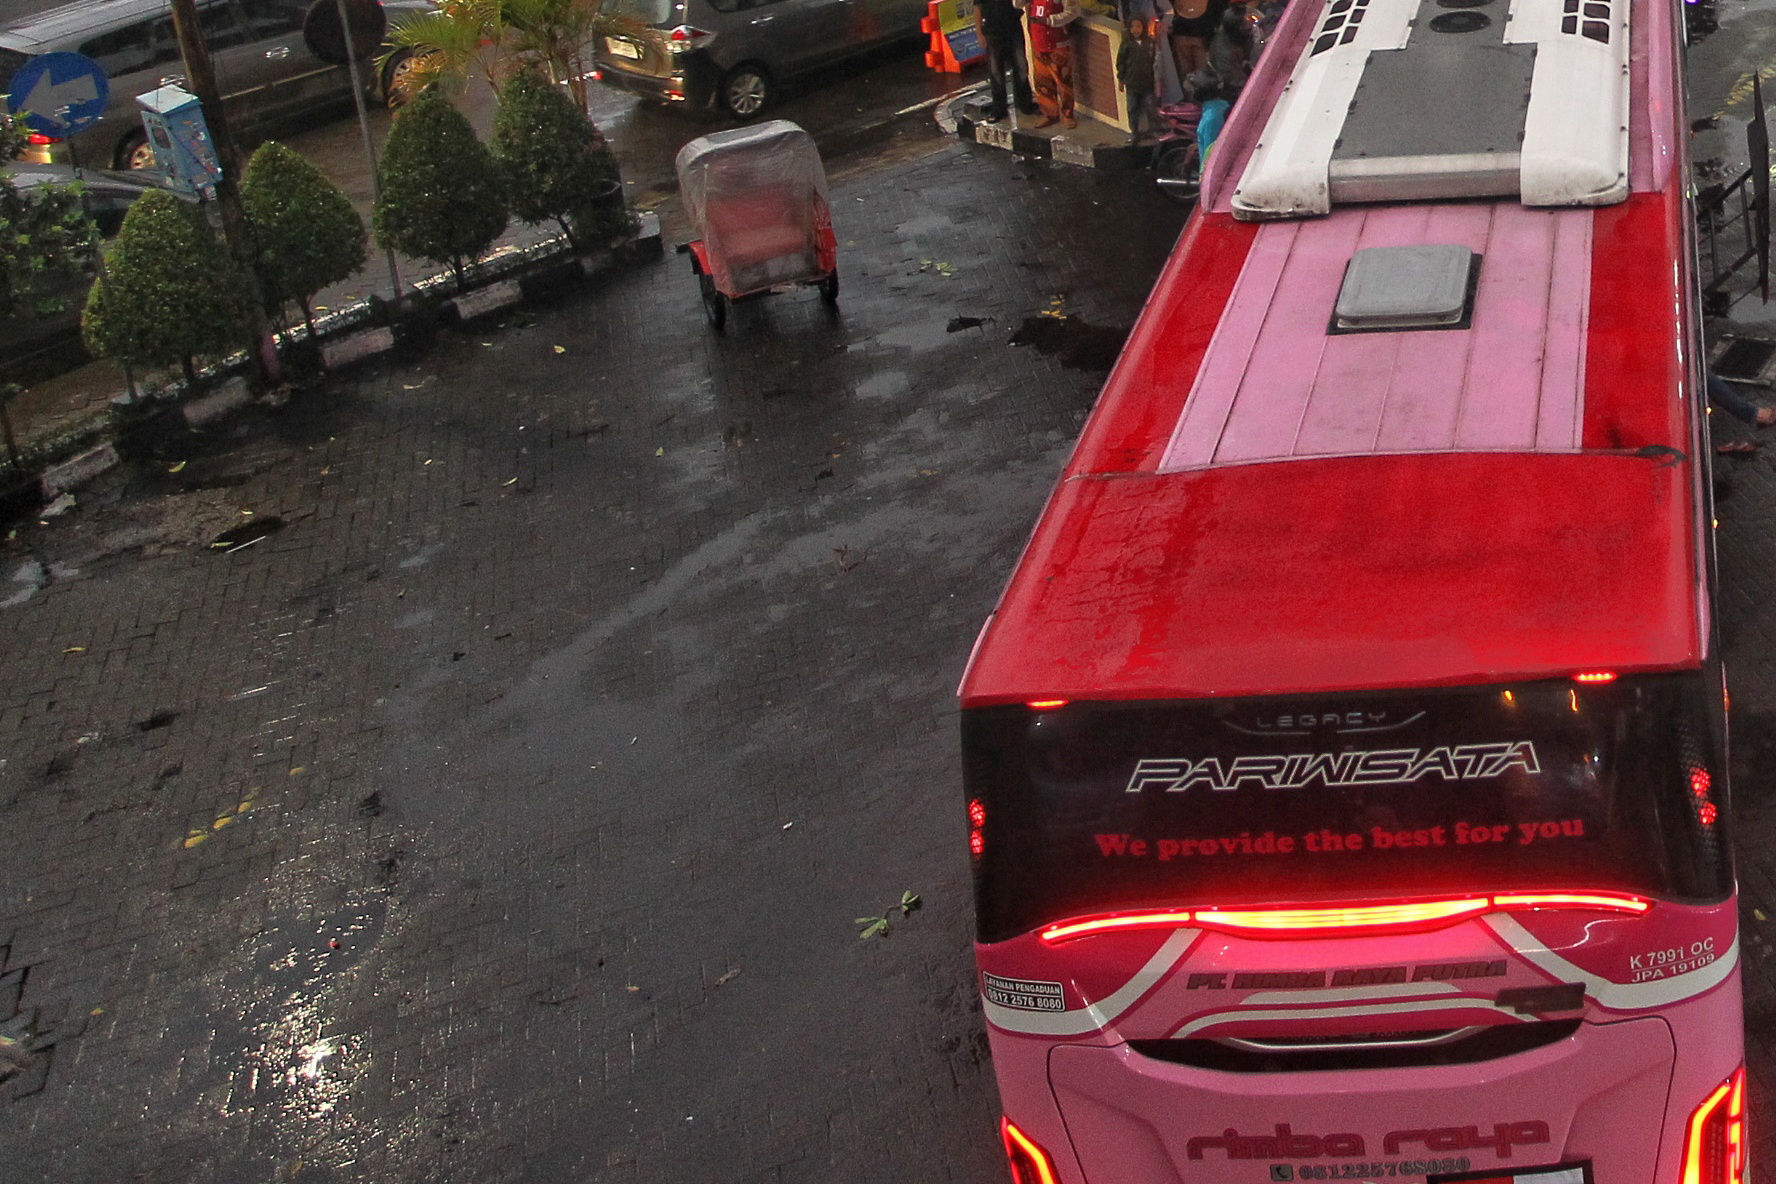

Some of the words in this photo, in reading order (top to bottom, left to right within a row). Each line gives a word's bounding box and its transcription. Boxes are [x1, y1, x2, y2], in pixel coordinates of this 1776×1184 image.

[1257, 712, 1387, 729] LEGACY
[1125, 741, 1541, 793] PARIWISATA
[1095, 832, 1147, 857] We
[1157, 831, 1295, 861] provide
[1305, 827, 1363, 852] the
[1371, 826, 1446, 849] best
[1455, 821, 1510, 845] for
[1518, 819, 1585, 845] you
[1630, 954, 1643, 969] K
[1647, 946, 1685, 966] 7991
[1691, 937, 1714, 955] OC
[1631, 968, 1664, 983] JPA
[1669, 953, 1715, 975] 19109
[985, 976, 1015, 992] LAYANAN
[1015, 982, 1061, 996] PENGADUAN
[1331, 966, 1407, 987] RAYA
[1411, 959, 1508, 982] PUTRA
[988, 988, 1010, 1004] 0812
[1011, 994, 1035, 1007] 2576
[1037, 996, 1062, 1010] 8080
[1187, 1122, 1366, 1161] rimba
[1383, 1119, 1550, 1159] raya
